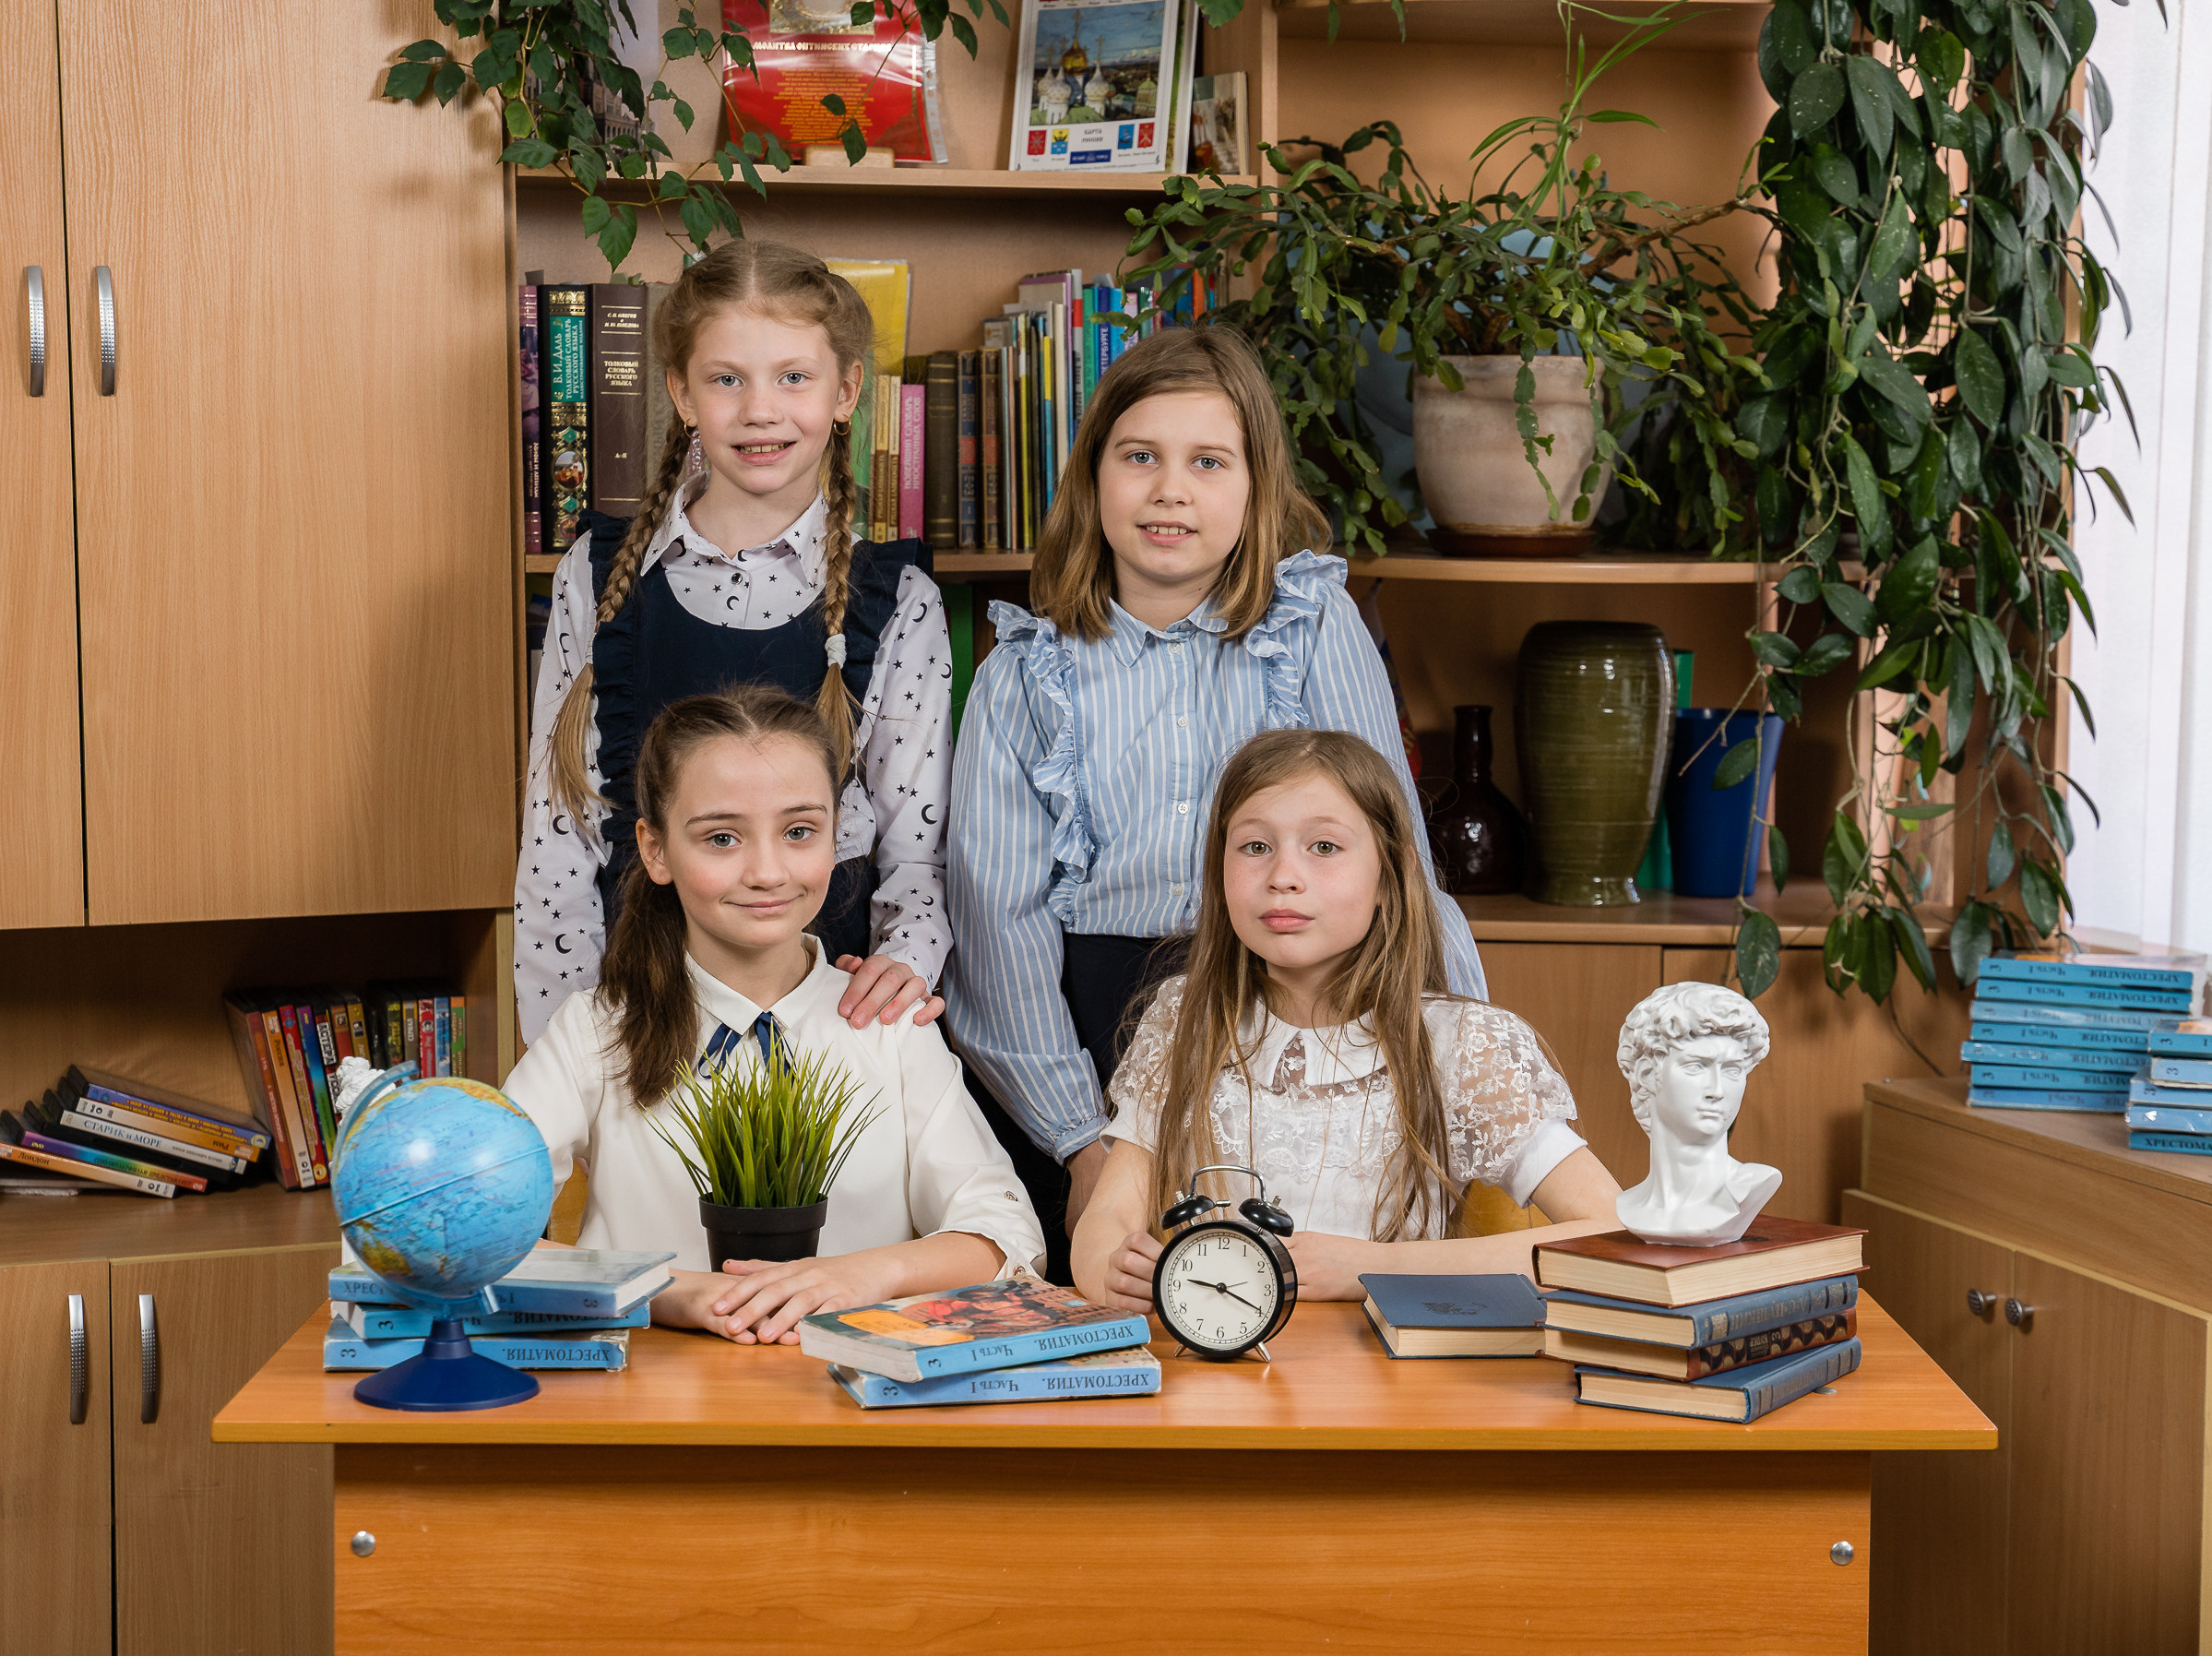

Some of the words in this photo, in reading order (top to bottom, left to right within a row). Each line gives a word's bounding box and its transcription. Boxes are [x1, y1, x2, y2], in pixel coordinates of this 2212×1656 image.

[565, 355, 573, 399] ТОЛКОВЫЙ
[2166, 1067, 2179, 1076] 3
[84, 1117, 123, 1138] СТАРИК
[134, 1135, 162, 1149] МОРЕ
[212, 1140, 229, 1150] Рим
[18, 1150, 50, 1165] Лондон
[1218, 1237, 1231, 1250] 12
[1197, 1244, 1207, 1257] 11
[1242, 1245, 1247, 1257] 1
[1182, 1259, 1194, 1271] 10
[1257, 1261, 1266, 1273] 2
[1172, 1280, 1181, 1292] 9
[1264, 1284, 1272, 1297] 3
[583, 1298, 598, 1308] 3
[1179, 1302, 1187, 1314] 8
[1255, 1305, 1264, 1317] 4
[378, 1319, 395, 1330] 3
[1196, 1318, 1204, 1331] 7
[1239, 1322, 1248, 1334] 5
[1034, 1324, 1134, 1351] ХРЕСТОМАТИЯ.
[1216, 1326, 1225, 1339] 6
[1771, 1330, 1781, 1341] 3
[340, 1348, 357, 1358] 3
[502, 1348, 610, 1361] ХРЕСТОМАТИЯ.
[927, 1357, 942, 1368] 3
[1042, 1374, 1149, 1390] ХРЕСТОМАТИЯ.
[883, 1386, 898, 1397] 3
